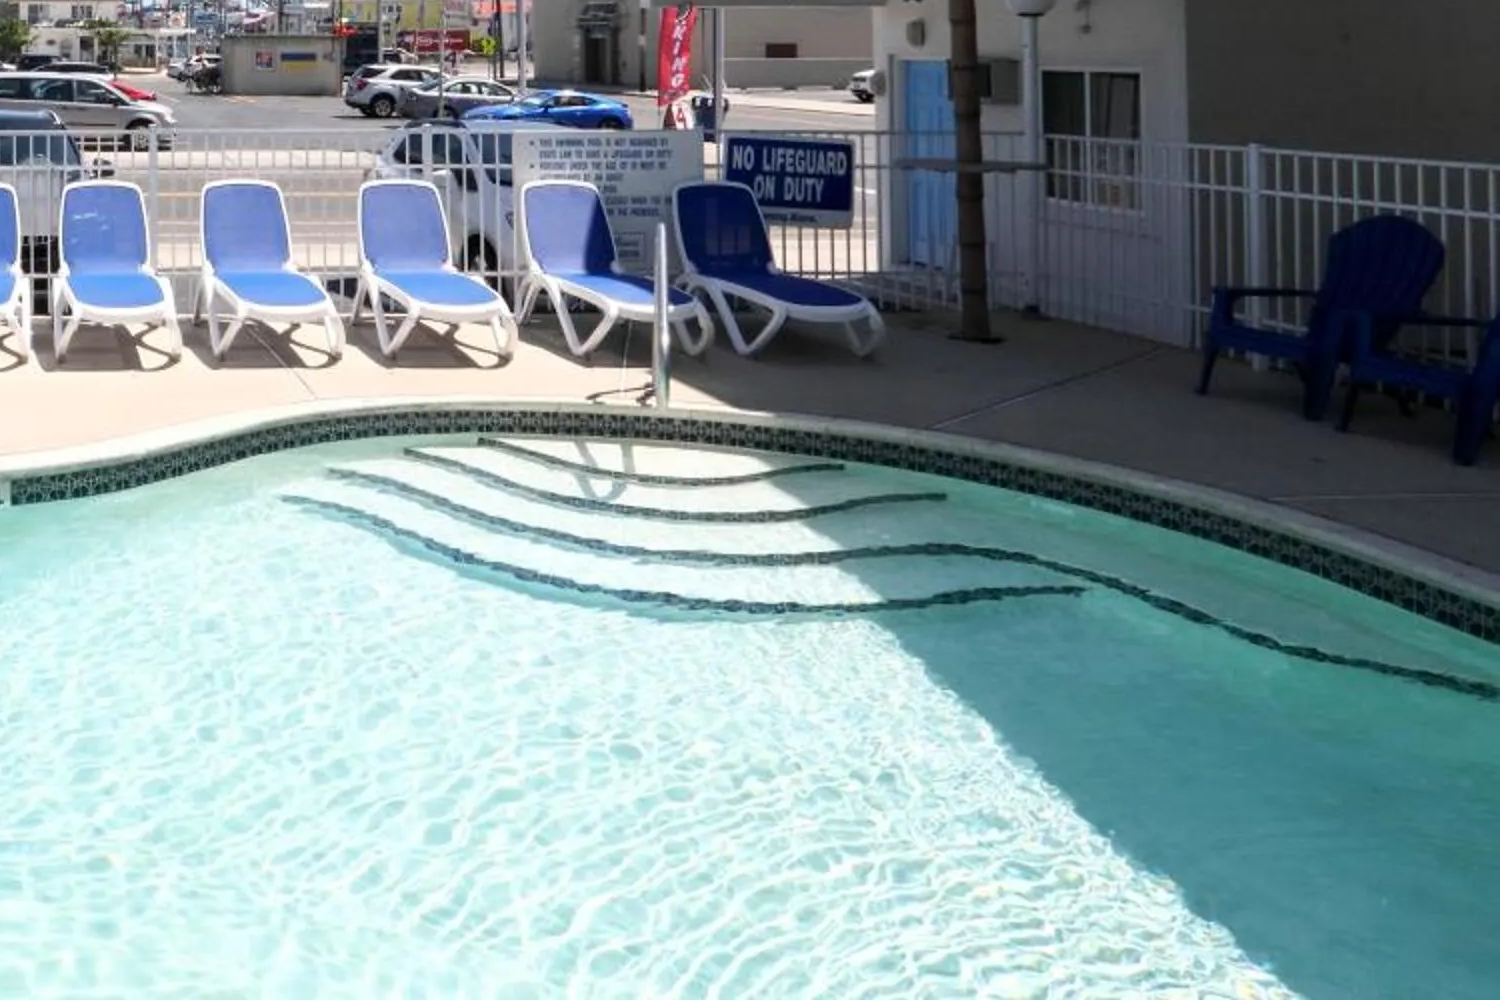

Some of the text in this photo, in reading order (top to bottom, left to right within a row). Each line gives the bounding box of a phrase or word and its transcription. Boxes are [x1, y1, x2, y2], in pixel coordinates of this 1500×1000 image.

[732, 145, 847, 175] NO LIFEGUARD
[754, 175, 824, 202] ON DUTY
